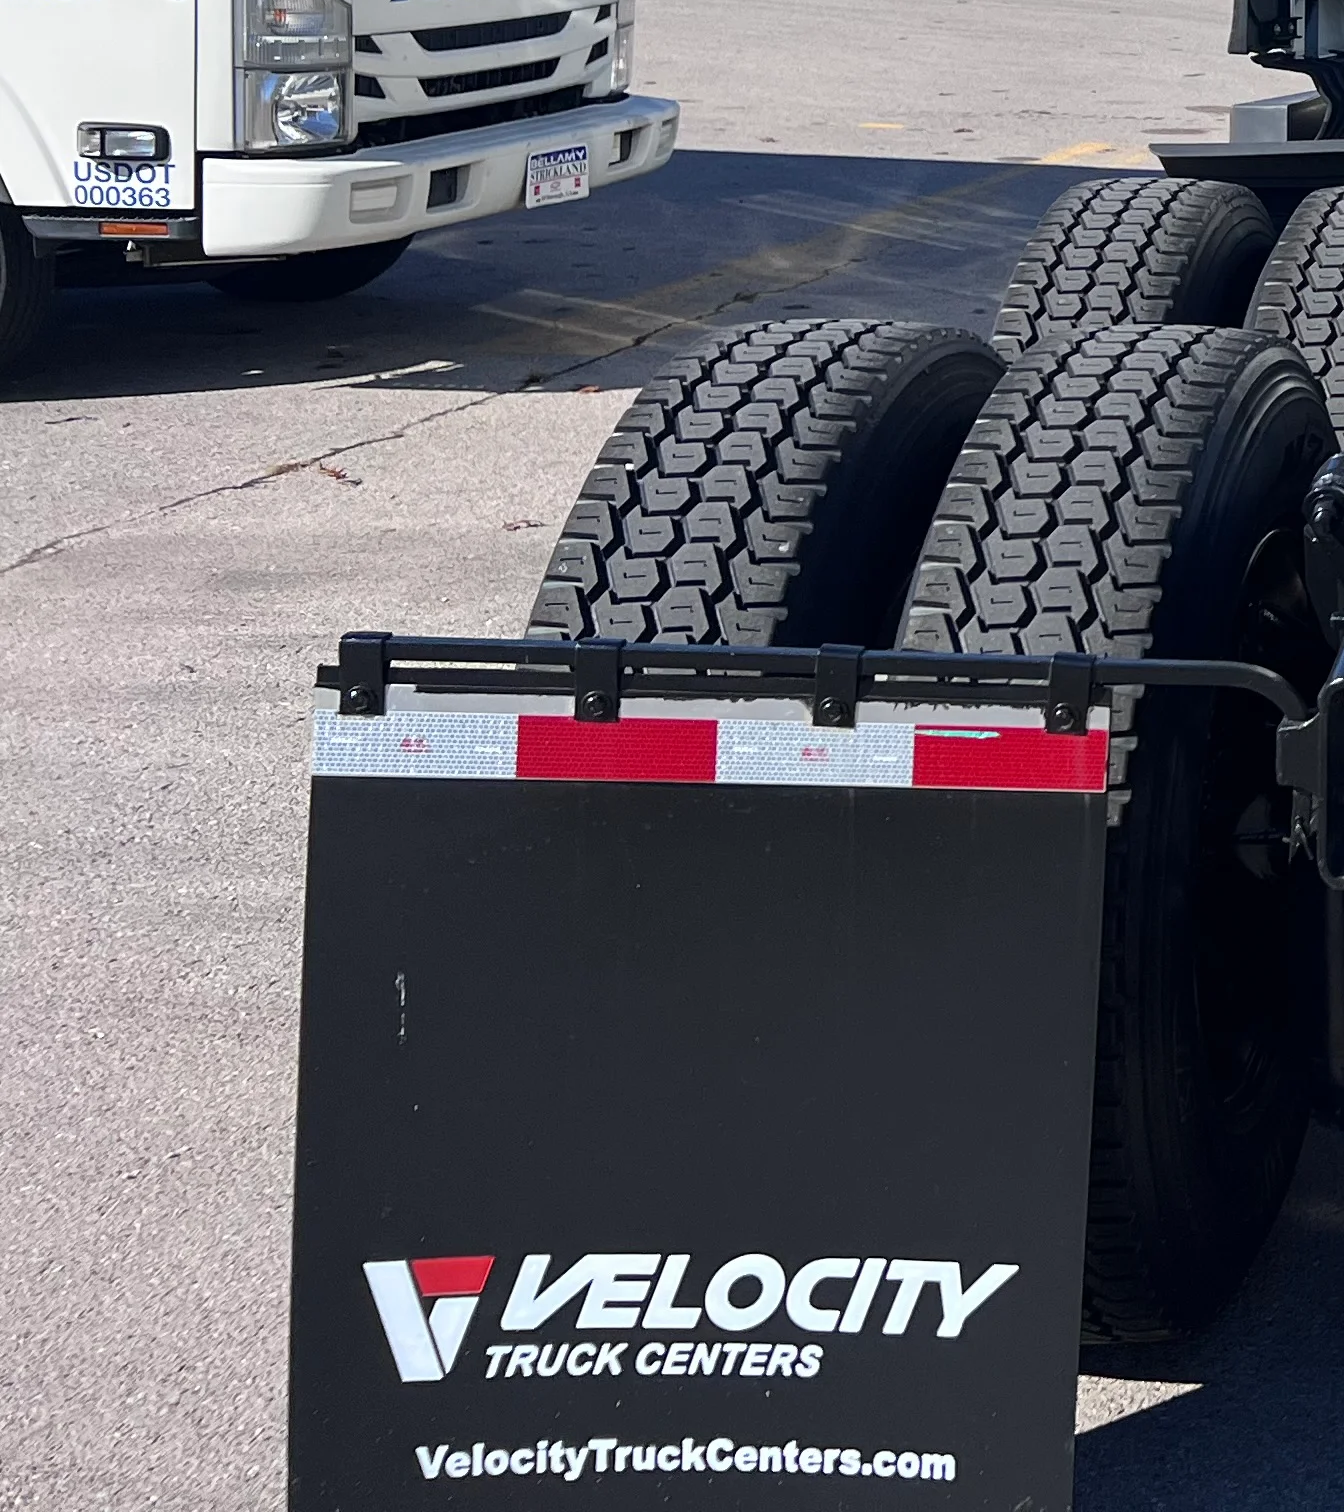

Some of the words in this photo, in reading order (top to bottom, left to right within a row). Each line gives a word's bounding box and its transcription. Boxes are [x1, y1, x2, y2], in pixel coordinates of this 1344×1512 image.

[530, 148, 585, 169] BELLAMY
[74, 160, 176, 185] USDOT
[530, 161, 587, 182] STRICKLAND
[75, 185, 171, 208] 000363
[499, 1253, 1020, 1338] VELOCITY
[485, 1342, 629, 1378] TRUCK
[635, 1342, 824, 1378] CENTERS
[415, 1437, 956, 1482] VelocityTruckCenters.com
